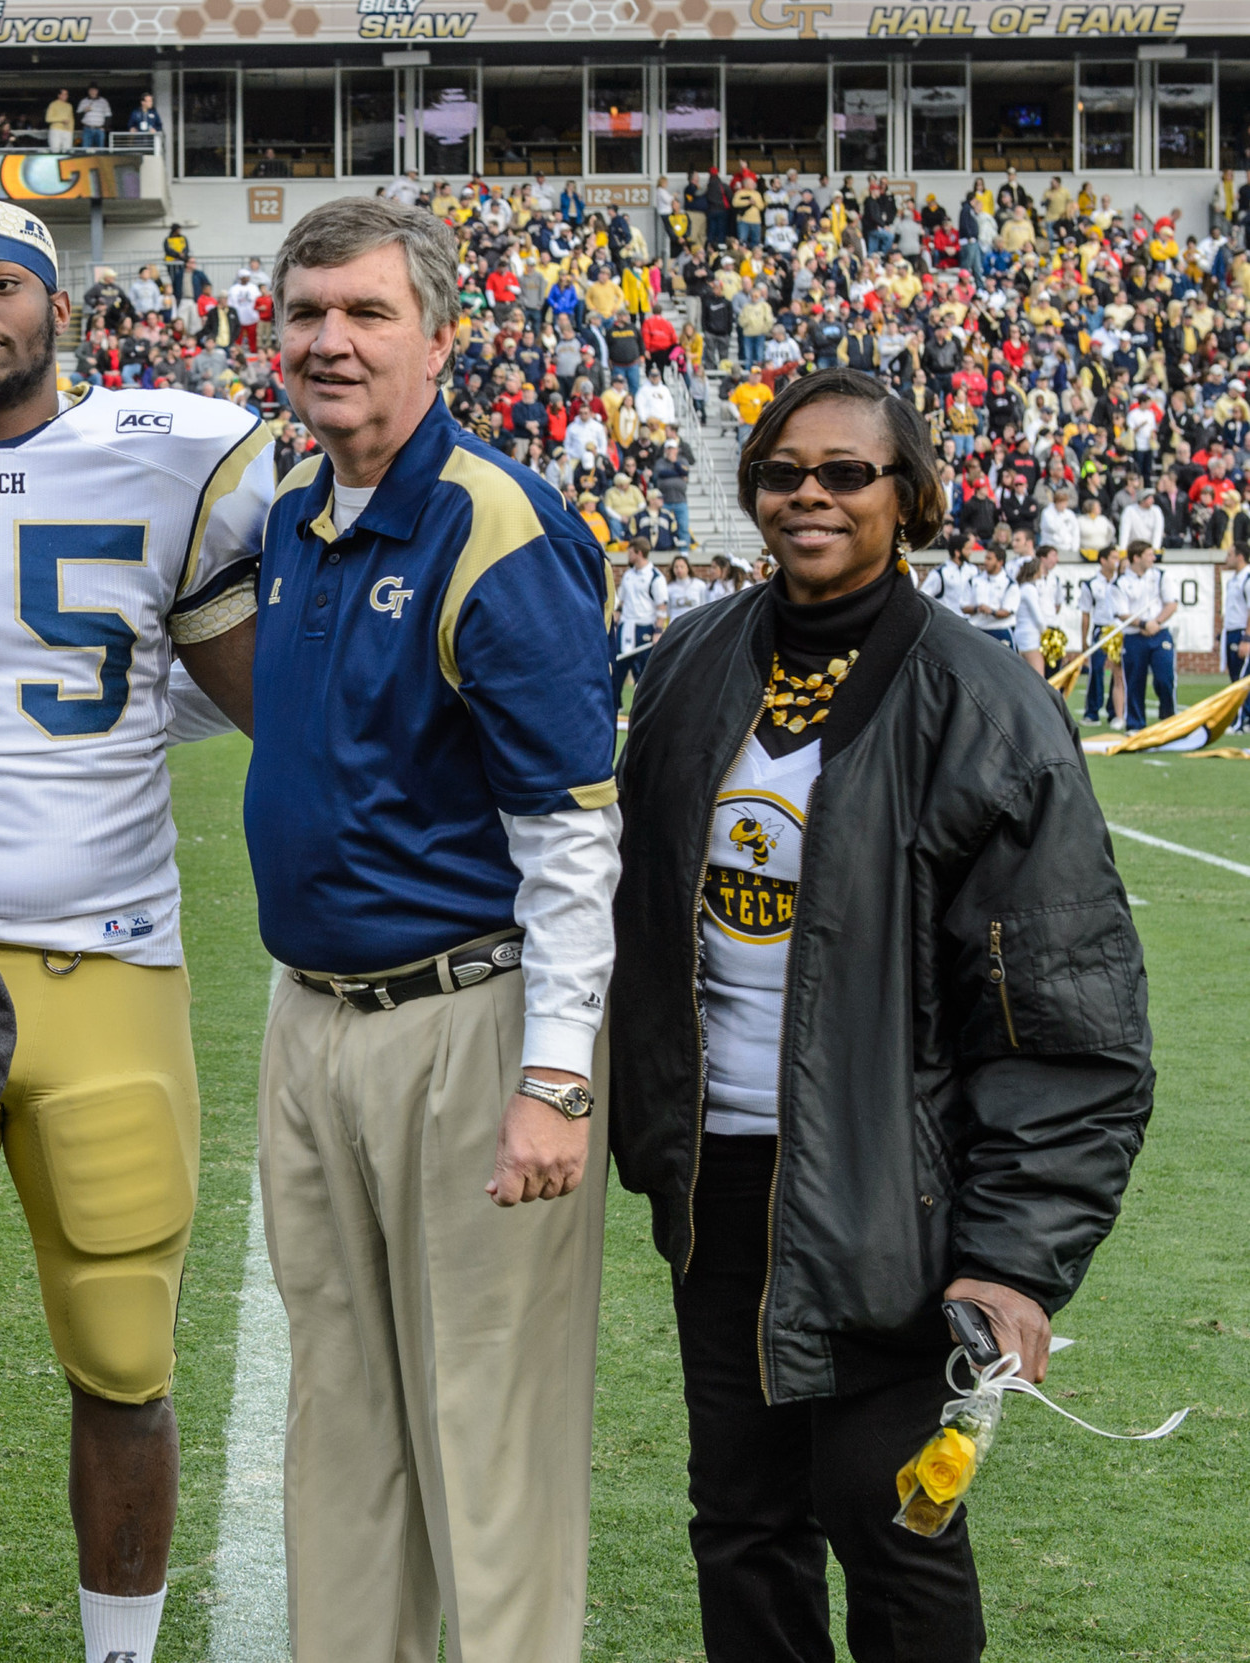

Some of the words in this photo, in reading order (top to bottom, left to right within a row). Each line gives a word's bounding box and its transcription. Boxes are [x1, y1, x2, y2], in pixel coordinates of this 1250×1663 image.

[357, 0, 424, 13] BILLY
[359, 12, 478, 38] SHAW
[867, 6, 976, 37] HALL
[988, 5, 1051, 36] OF
[1055, 4, 1185, 36] FAME
[253, 199, 280, 215] 122
[119, 414, 170, 427] ACC
[369, 576, 414, 619] GT
[720, 887, 794, 926] TECH
[132, 917, 149, 926] XL
